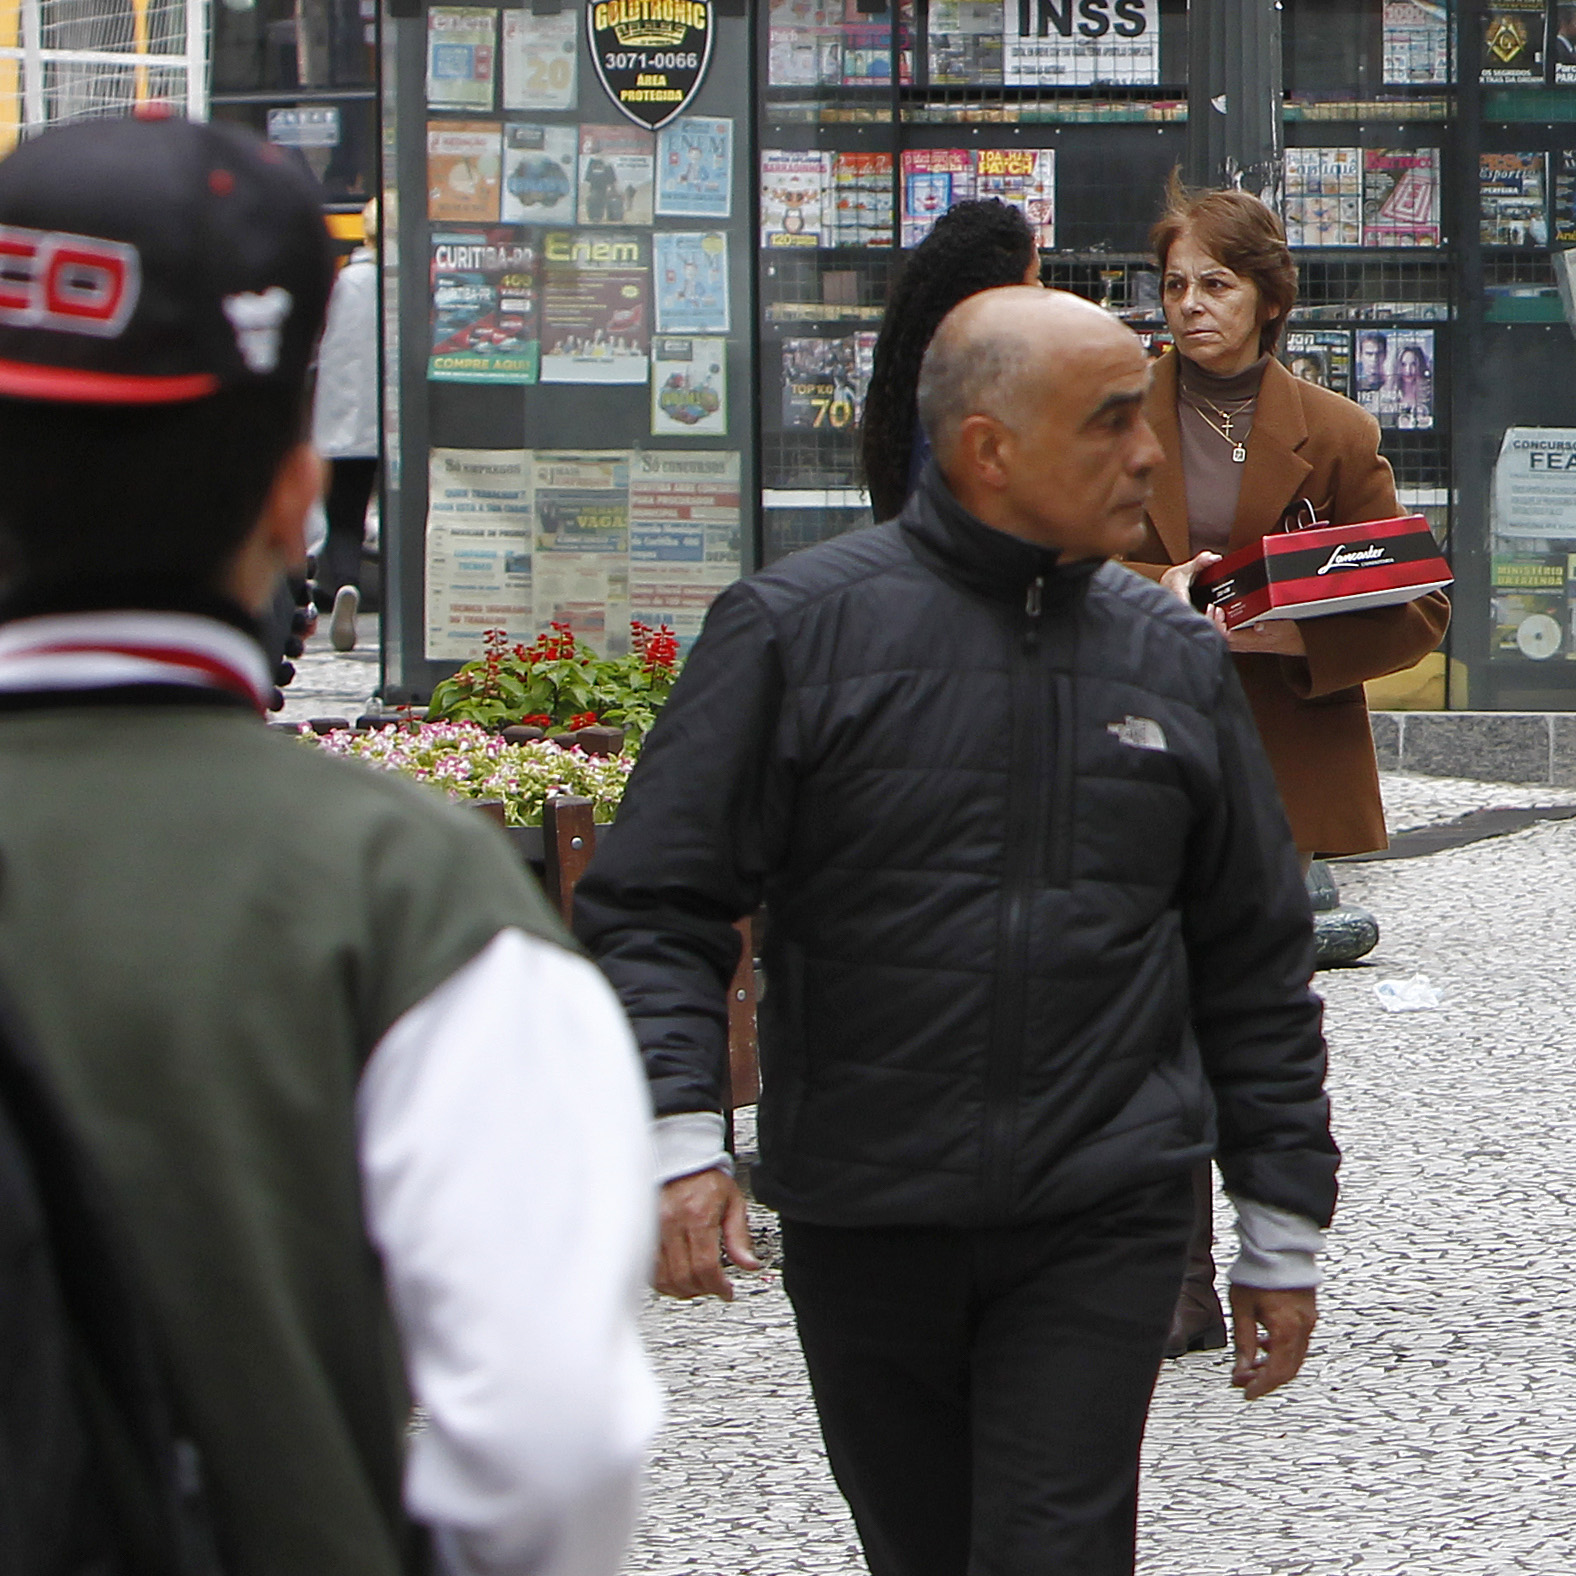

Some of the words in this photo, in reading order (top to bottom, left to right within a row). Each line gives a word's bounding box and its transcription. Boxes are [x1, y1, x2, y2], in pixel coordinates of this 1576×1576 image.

[604, 52, 698, 71] 3071-0066
[636, 73, 667, 87] ÁREA
[620, 89, 683, 102] PROTEGIDA
[979, 161, 1032, 174] PATCH
[545, 233, 639, 262] Enem
[434, 358, 489, 371] COMPRE
[791, 384, 813, 394] TOP
[811, 399, 853, 428] 70
[576, 515, 628, 528] VAGA
[1317, 543, 1386, 575] Lancaster
[1497, 566, 1563, 575] MINISTÉRIO
